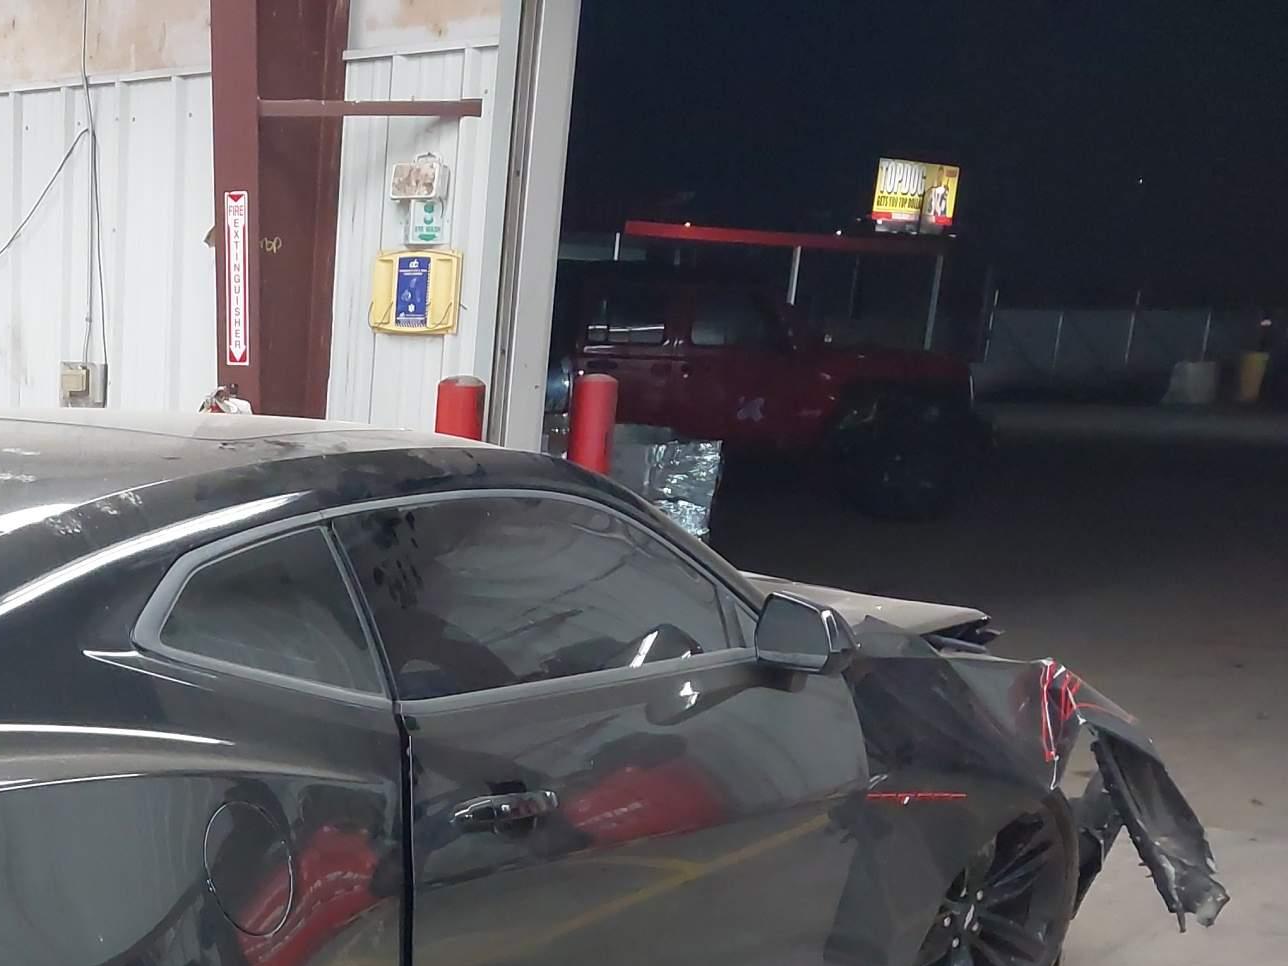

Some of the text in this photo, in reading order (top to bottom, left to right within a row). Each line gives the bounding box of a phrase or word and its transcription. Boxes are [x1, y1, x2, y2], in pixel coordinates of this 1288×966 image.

[876, 196, 889, 207] GETS
[899, 197, 908, 209] TOP
[228, 205, 244, 216] FIRE
[233, 219, 241, 349] EXTINGUISHER
